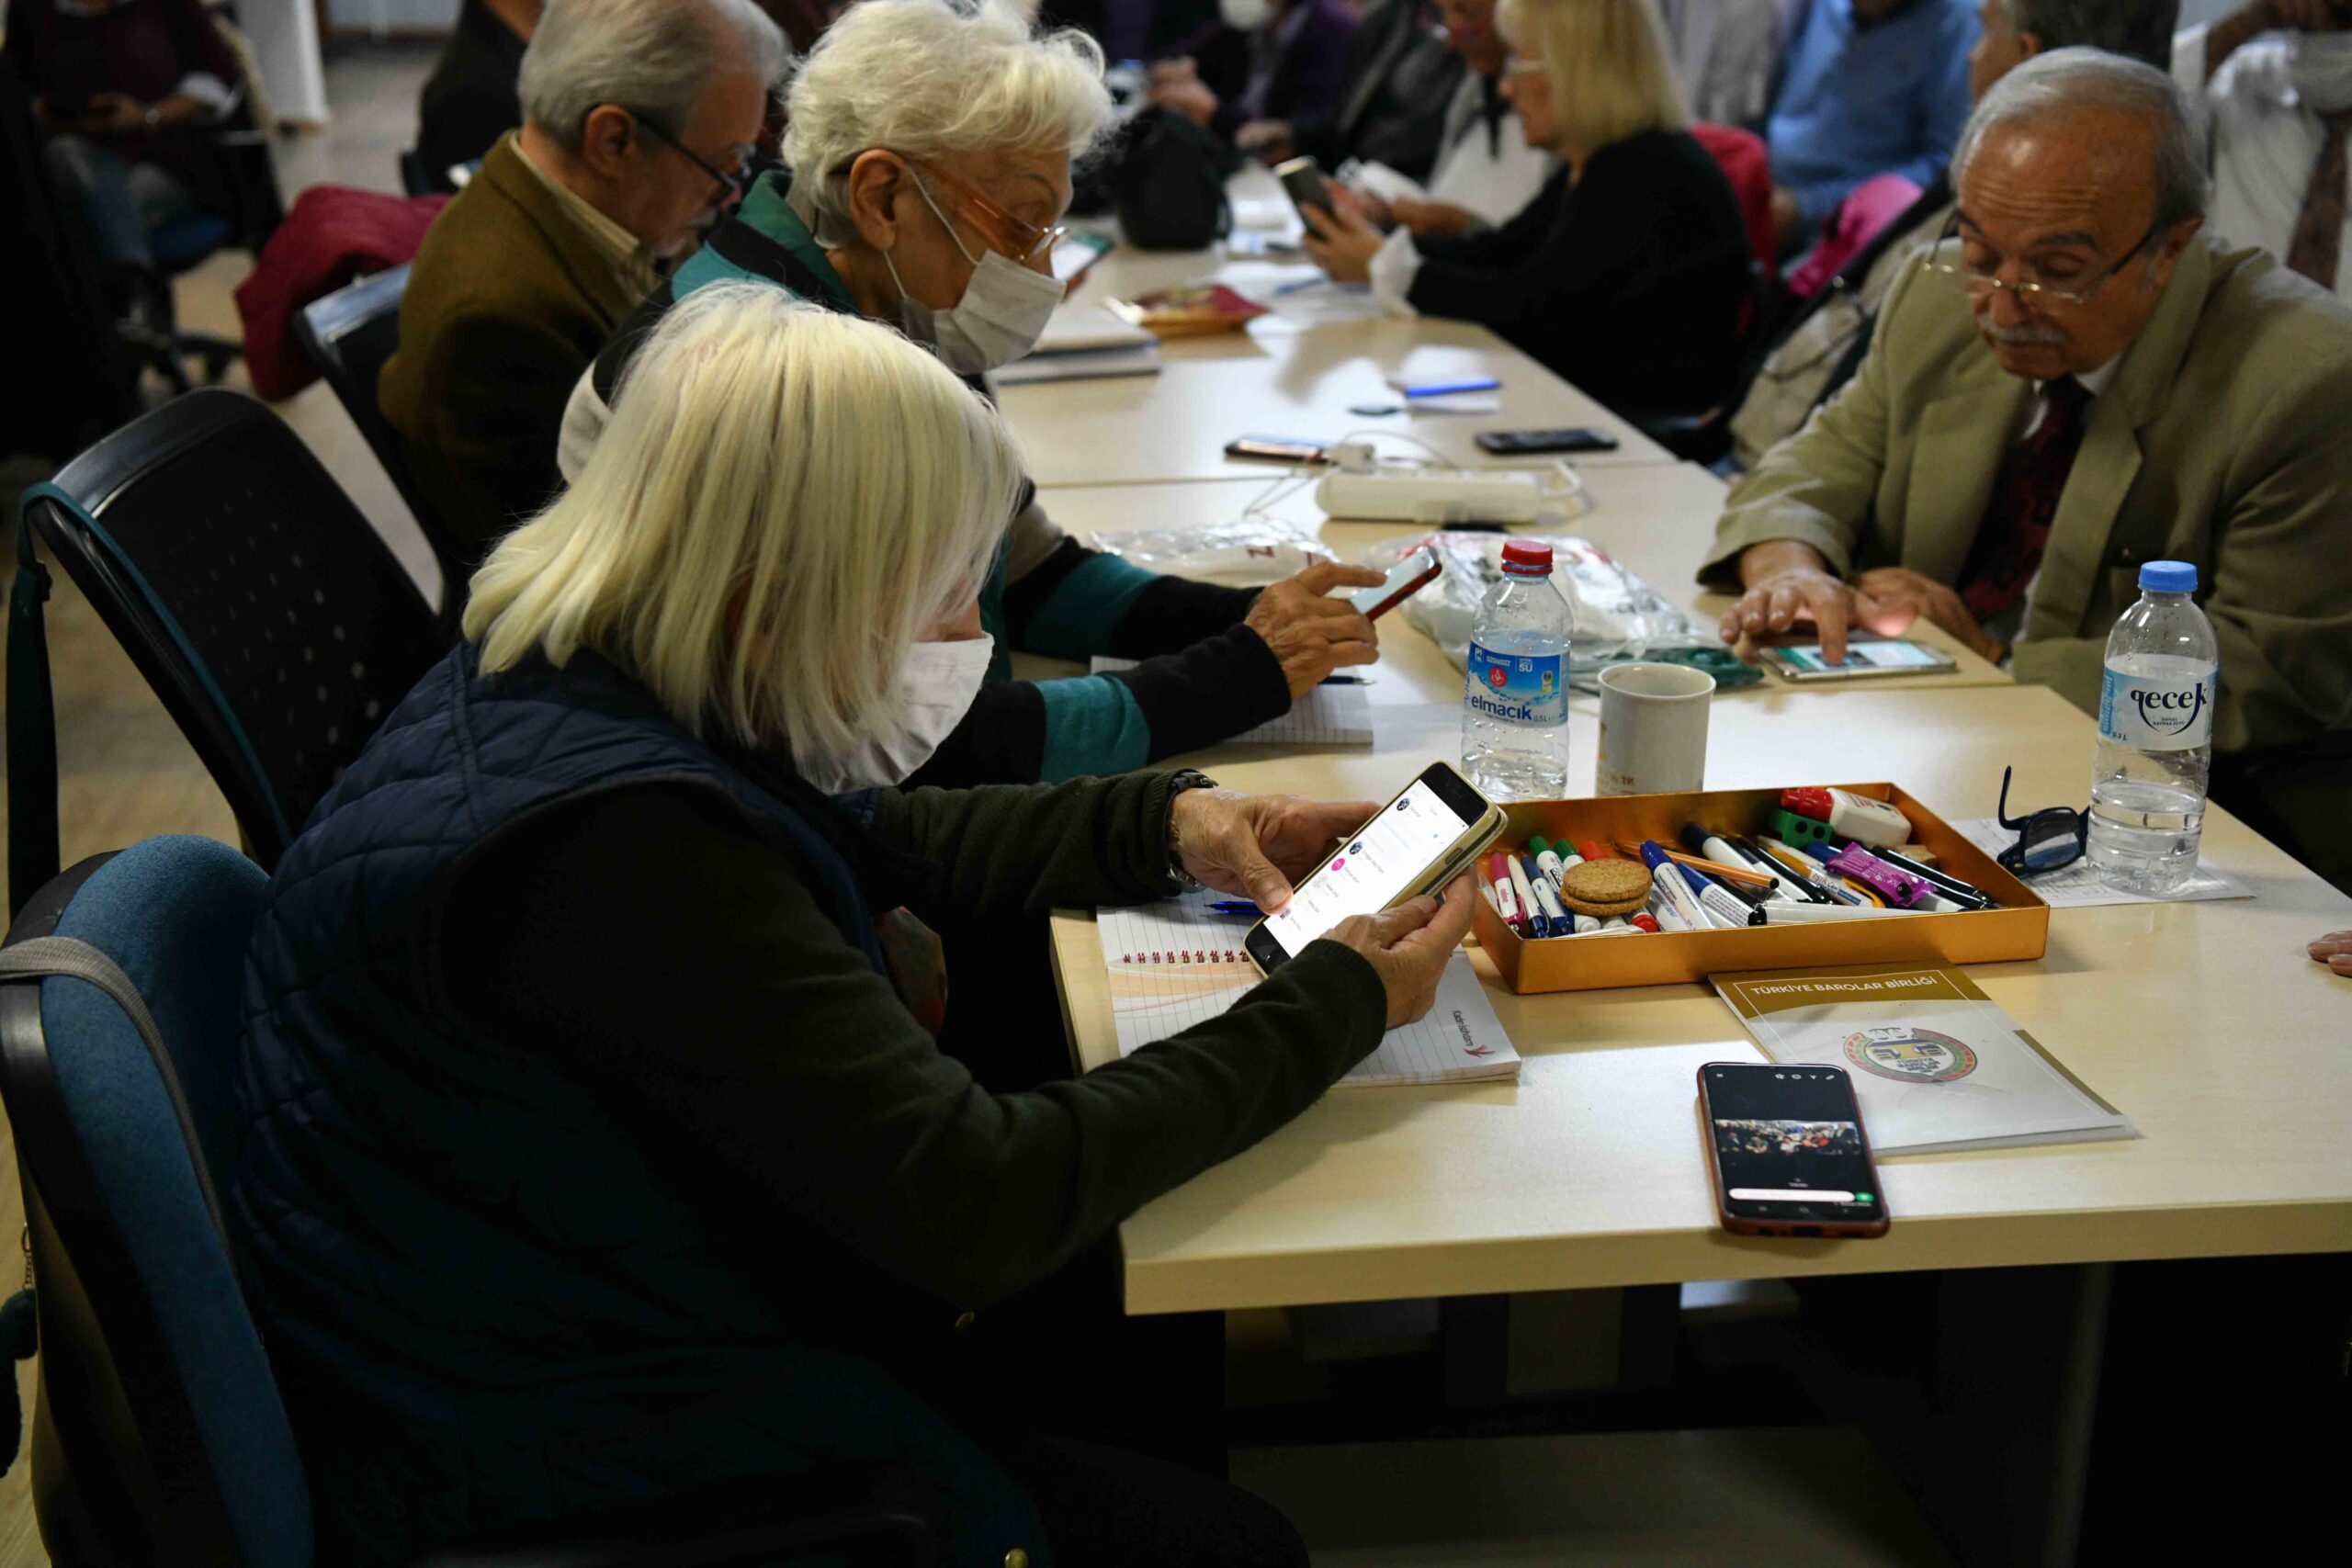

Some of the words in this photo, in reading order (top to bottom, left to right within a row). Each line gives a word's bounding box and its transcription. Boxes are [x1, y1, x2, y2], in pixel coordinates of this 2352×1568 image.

[1471, 694, 1532, 720] elmacık
[1751, 984, 1813, 995] TÜRKİYE
[1814, 982, 1884, 992] BAROLAR
[1885, 976, 1938, 989] BİRLİĞİ
